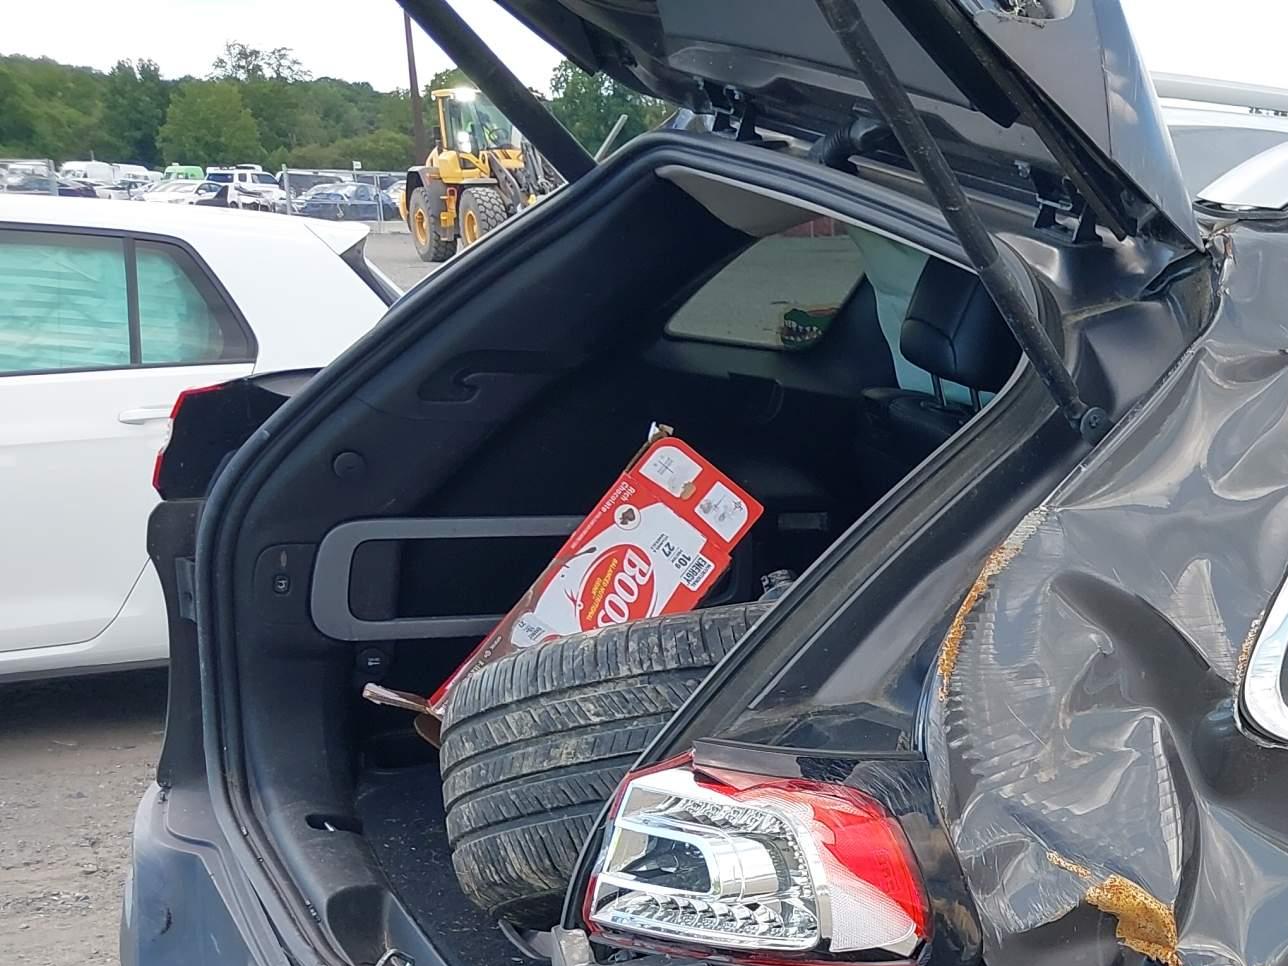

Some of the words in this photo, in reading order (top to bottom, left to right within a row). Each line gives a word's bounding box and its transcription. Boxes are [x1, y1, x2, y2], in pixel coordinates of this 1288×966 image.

[601, 481, 629, 512] Chocolate
[620, 486, 636, 501] Rich
[662, 542, 675, 557] 27
[675, 554, 691, 569] 10g
[602, 558, 618, 587] BALANCED
[683, 557, 707, 584] ENERGY
[596, 548, 652, 628] BOOS
[585, 585, 606, 621] NUTRITIONAL
